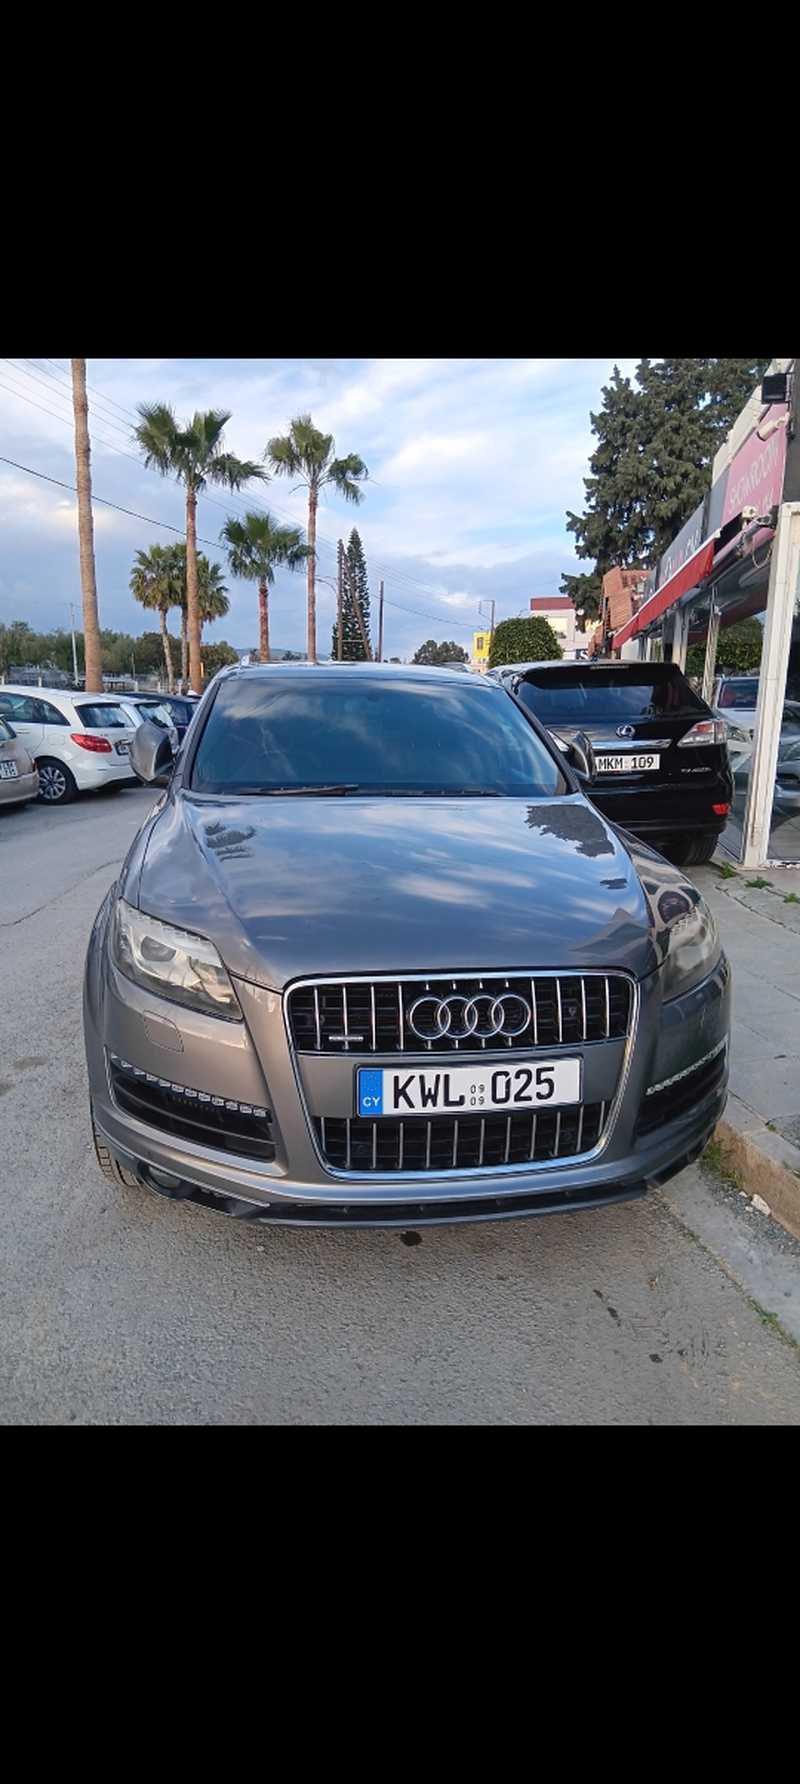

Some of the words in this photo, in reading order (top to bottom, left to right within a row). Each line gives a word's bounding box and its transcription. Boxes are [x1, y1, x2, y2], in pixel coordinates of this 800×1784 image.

[598, 757, 623, 770] MKM
[631, 756, 655, 769] 109
[393, 1074, 465, 1109] KWL
[491, 1066, 555, 1104] 025
[470, 1084, 485, 1094] 09
[362, 1096, 381, 1108] CY
[470, 1096, 485, 1106] 09
